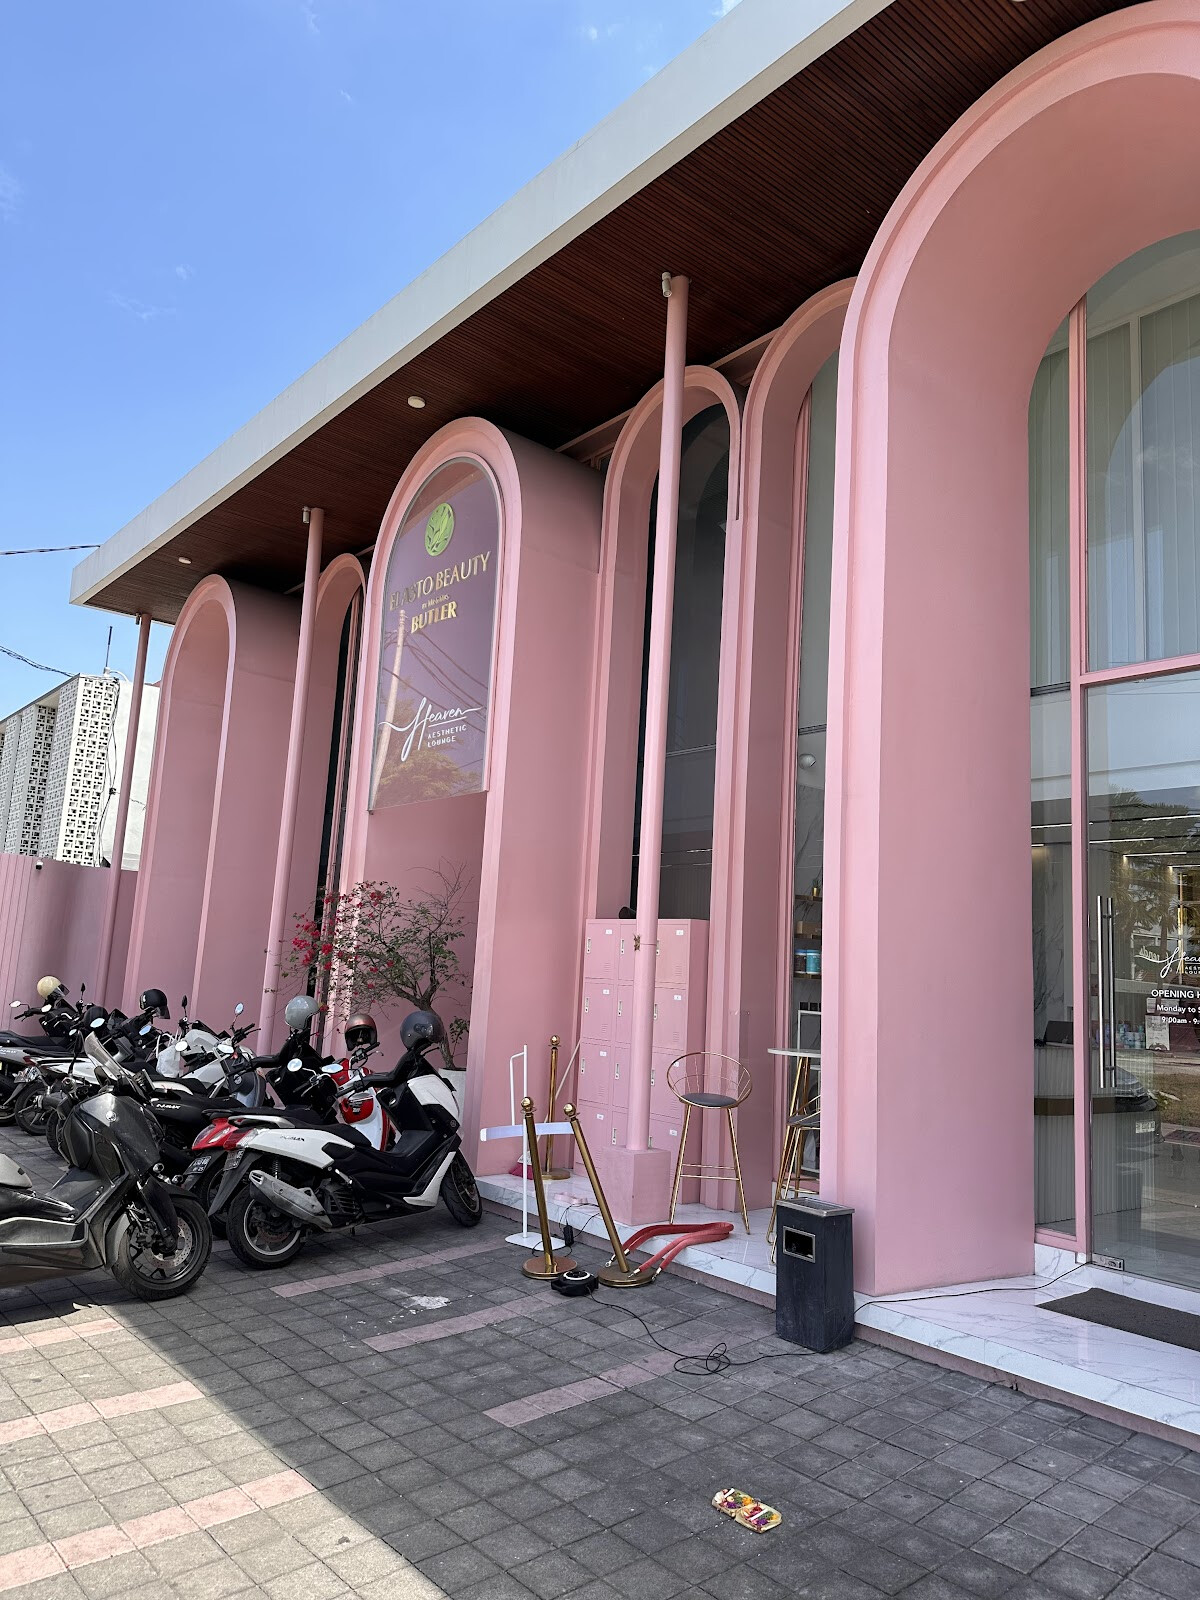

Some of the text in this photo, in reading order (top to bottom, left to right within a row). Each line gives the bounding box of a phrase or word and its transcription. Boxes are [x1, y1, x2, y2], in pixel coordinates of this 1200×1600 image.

[389, 576, 433, 611] ELASTO
[435, 551, 491, 590] BEAUTY
[411, 601, 457, 634] BUTLER
[378, 697, 483, 761] Heaven
[427, 724, 467, 740] AESTHETIC
[427, 735, 456, 748] LOUNGE
[1151, 989, 1195, 999] OPENING
[1156, 1004, 1186, 1014] Monday
